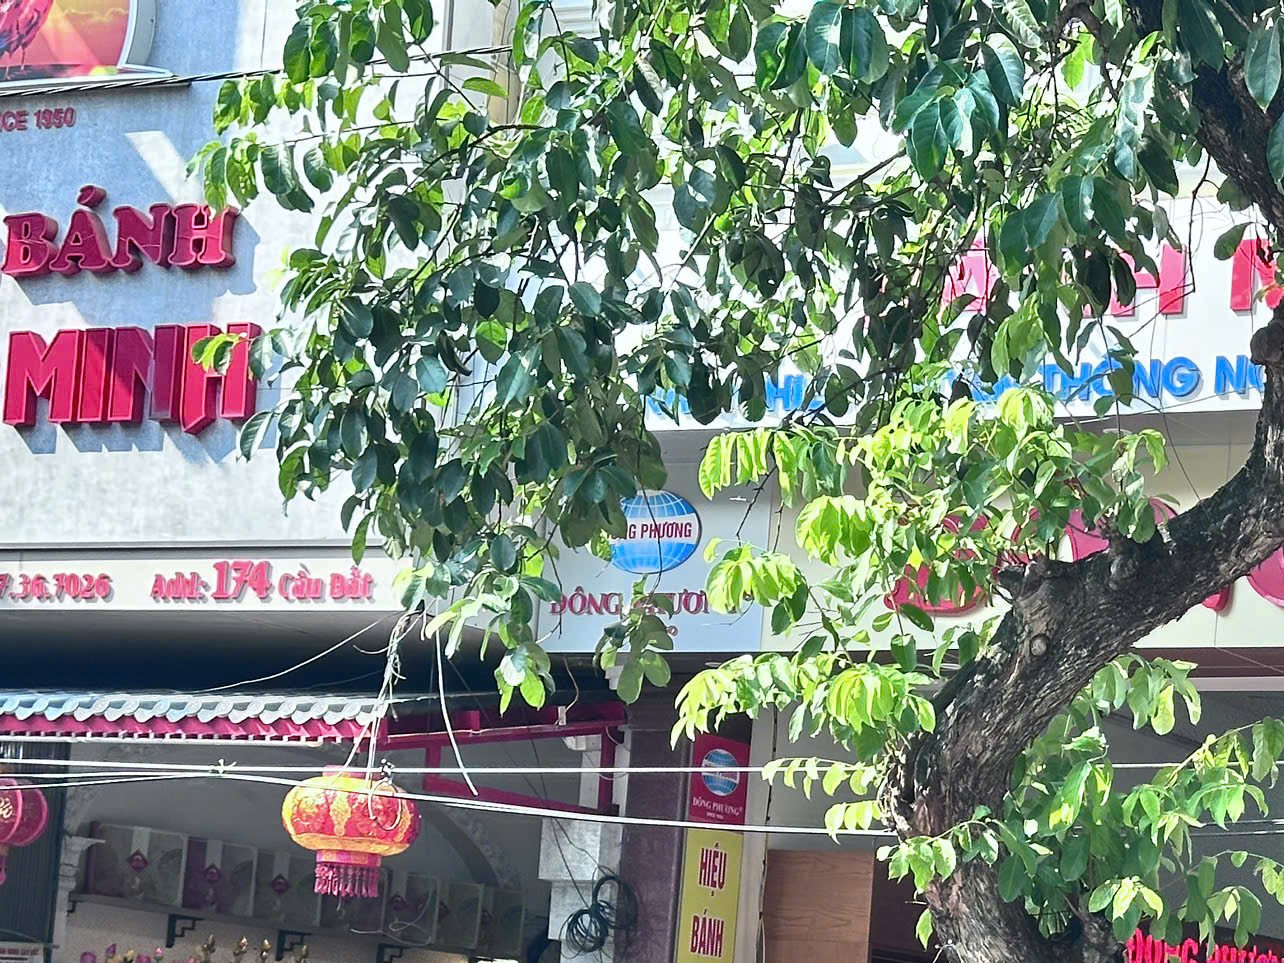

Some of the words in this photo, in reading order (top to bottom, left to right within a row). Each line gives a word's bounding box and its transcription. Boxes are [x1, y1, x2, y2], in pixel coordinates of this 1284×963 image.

[2, 185, 240, 277] BÁNH
[3, 322, 263, 435] MINH
[640, 521, 692, 539] PHƯƠNG
[212, 560, 274, 600] 174
[550, 586, 620, 615] ĐÔNG
[699, 842, 727, 896] HIỆU
[691, 909, 724, 958] BÁNH
